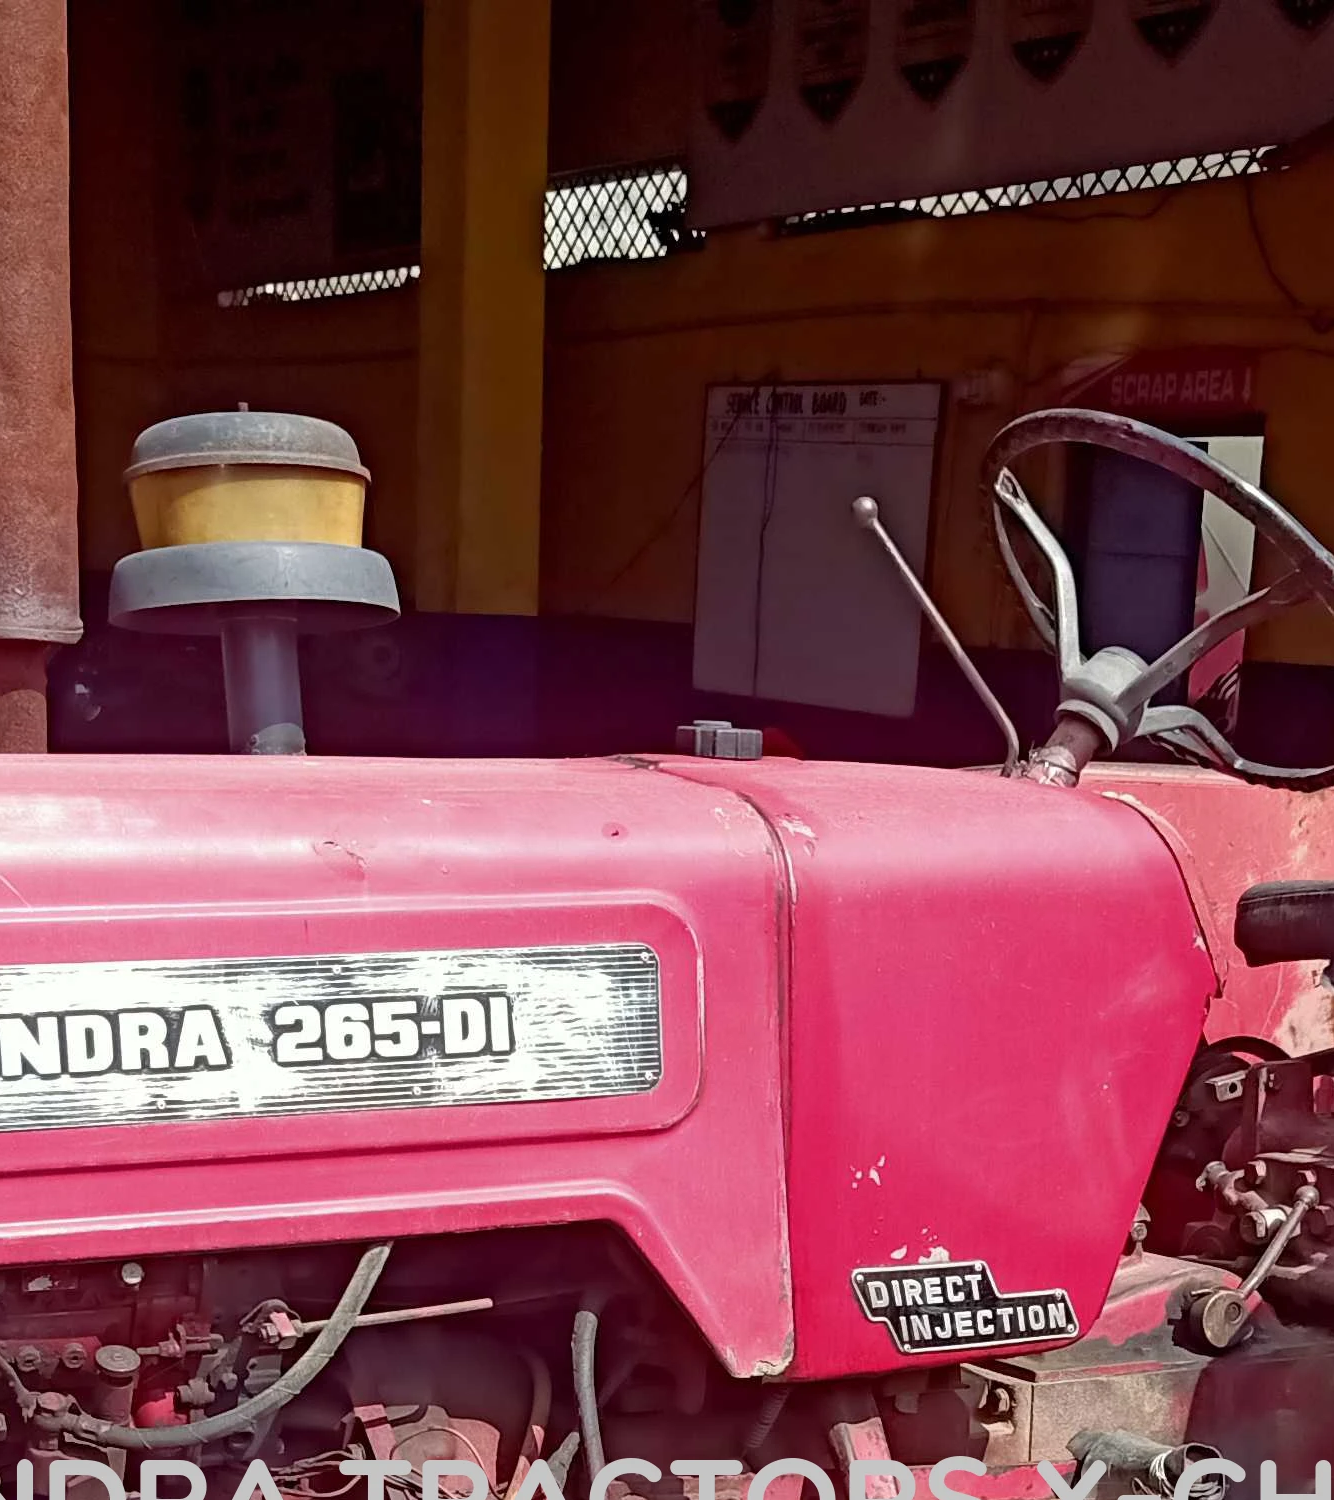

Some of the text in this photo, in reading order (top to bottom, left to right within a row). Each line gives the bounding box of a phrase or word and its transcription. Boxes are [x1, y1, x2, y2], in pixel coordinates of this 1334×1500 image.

[1110, 368, 1236, 406] SCRAP AREA
[273, 997, 513, 1064] 265-DI
[867, 1274, 983, 1309] DIRECT
[900, 1302, 1067, 1341] INJECTION
